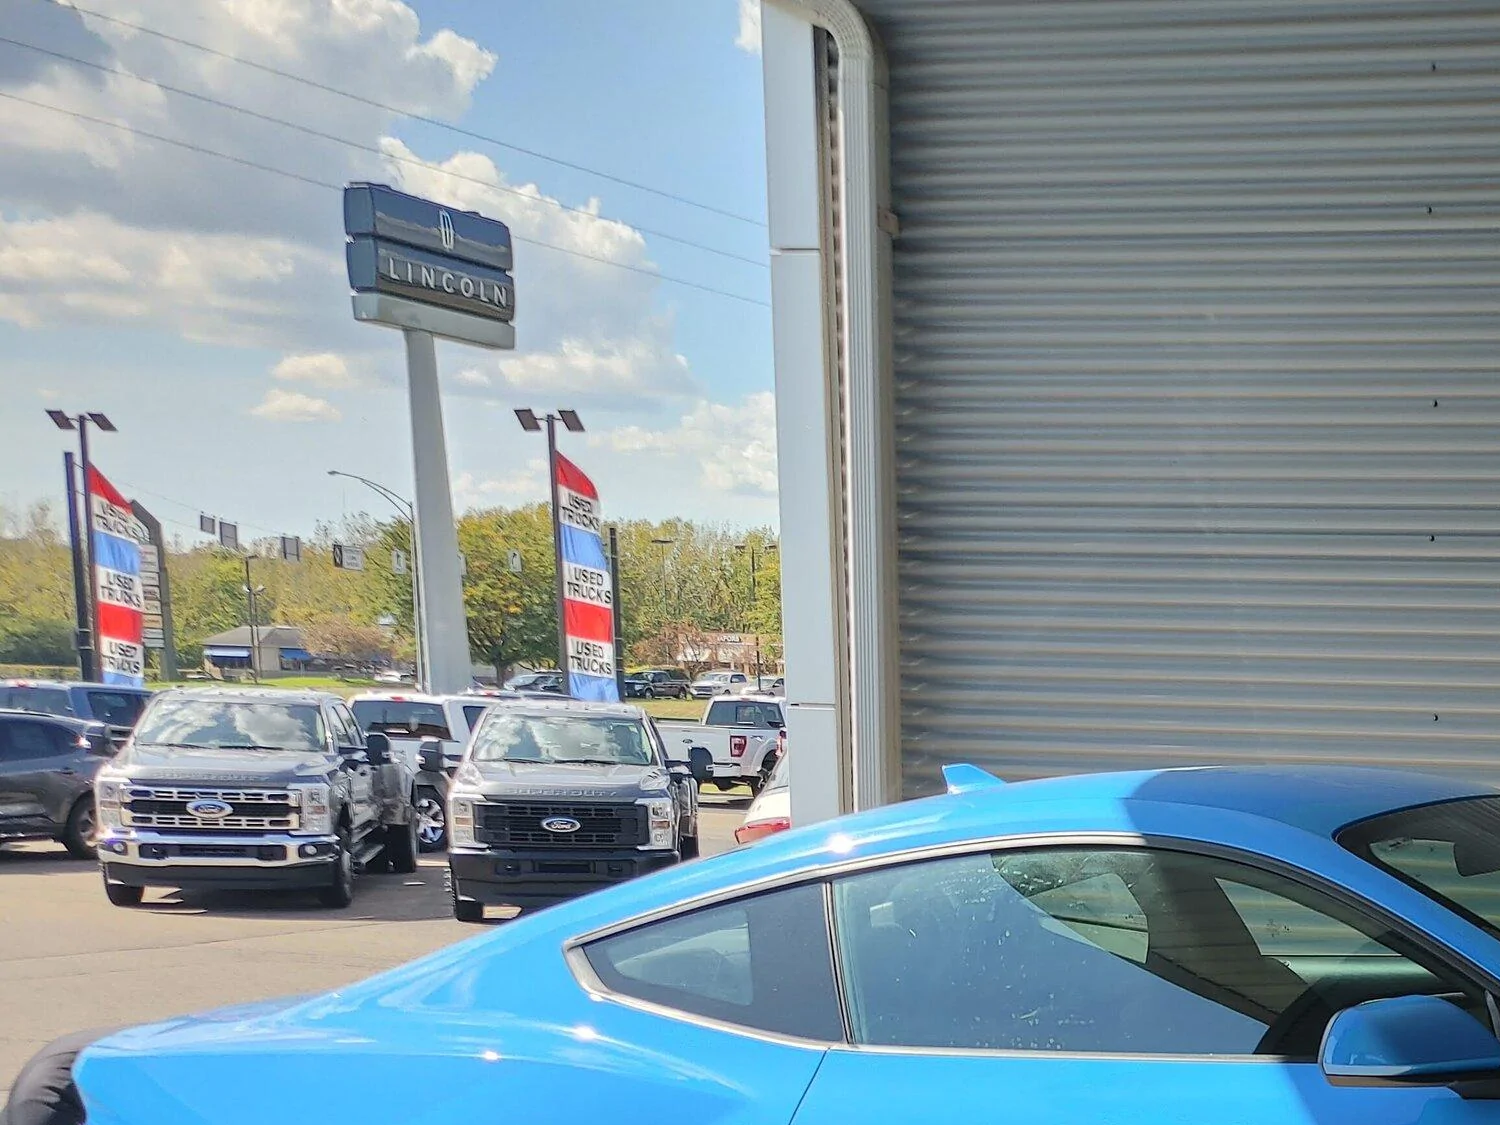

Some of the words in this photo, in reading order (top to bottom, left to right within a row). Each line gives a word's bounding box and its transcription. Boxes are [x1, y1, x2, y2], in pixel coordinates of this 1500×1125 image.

[389, 257, 507, 308] LINCOLN
[568, 492, 592, 514] USED
[107, 572, 133, 591] USED
[573, 566, 604, 586] USED
[567, 582, 611, 604] TRUCKS
[109, 641, 137, 658] USED
[576, 640, 604, 659] USED
[570, 655, 612, 675] TRUCKS
